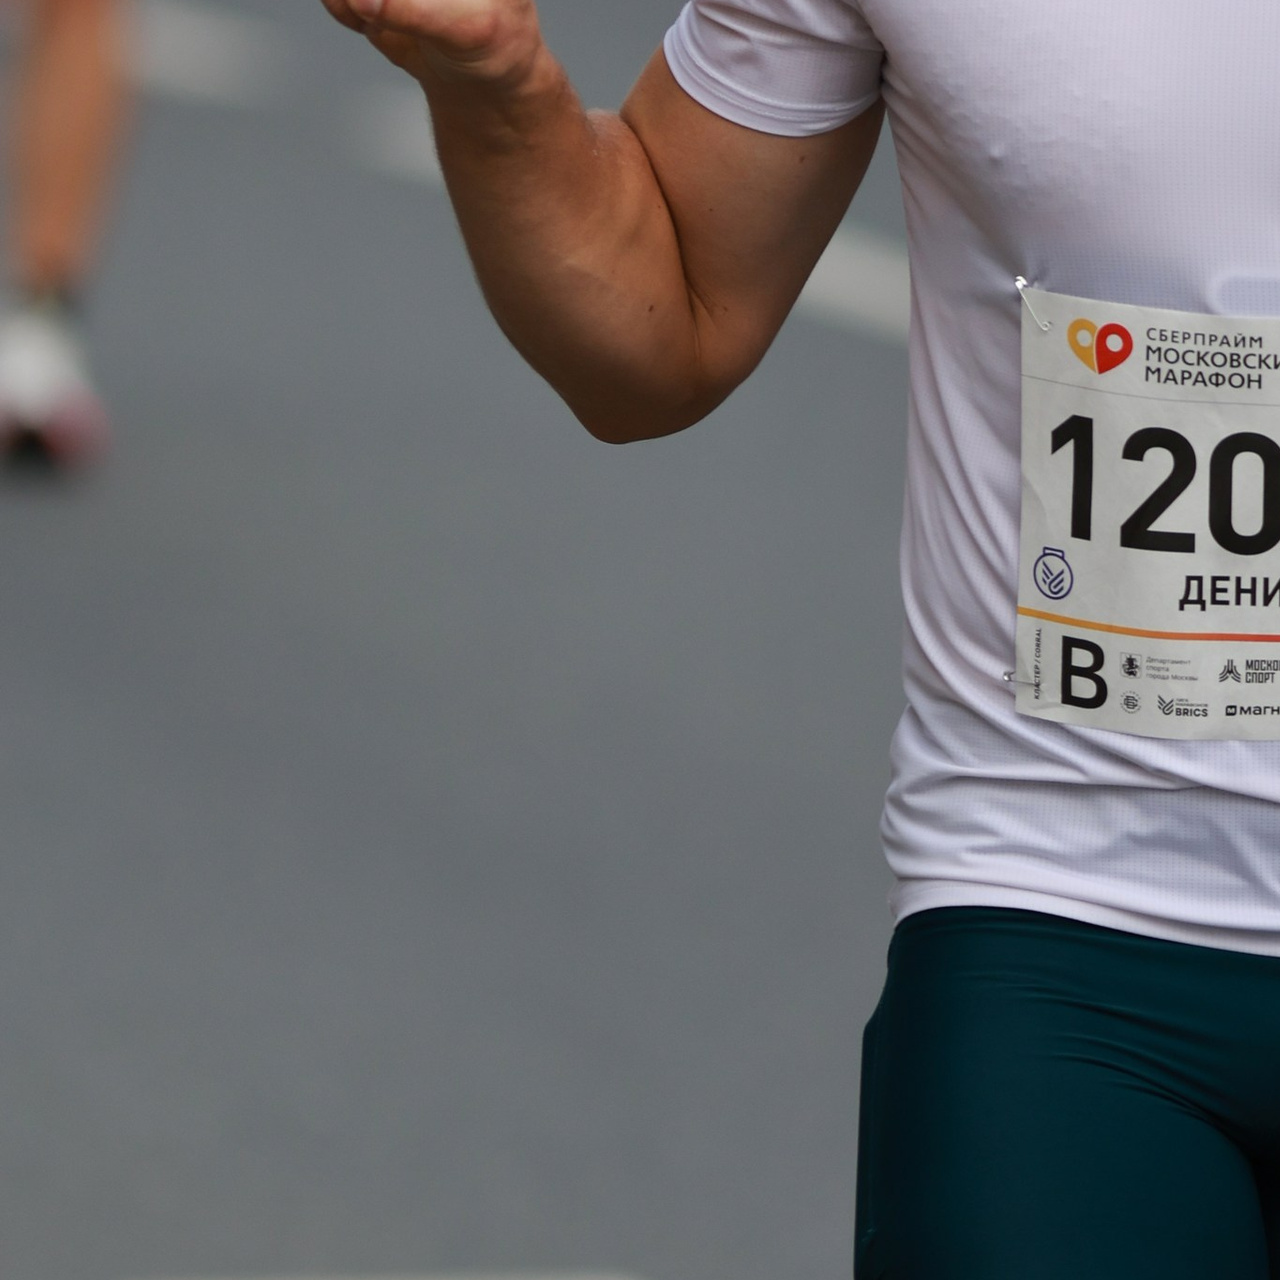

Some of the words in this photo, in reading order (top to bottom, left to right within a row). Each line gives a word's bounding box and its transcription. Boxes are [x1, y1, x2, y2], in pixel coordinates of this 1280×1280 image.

[1146, 327, 1263, 349] СБЕРПРАЙМ
[1145, 366, 1263, 390] МАРАФОН
[1245, 672, 1275, 683] СПОРТ
[1175, 708, 1208, 717] BRICS
